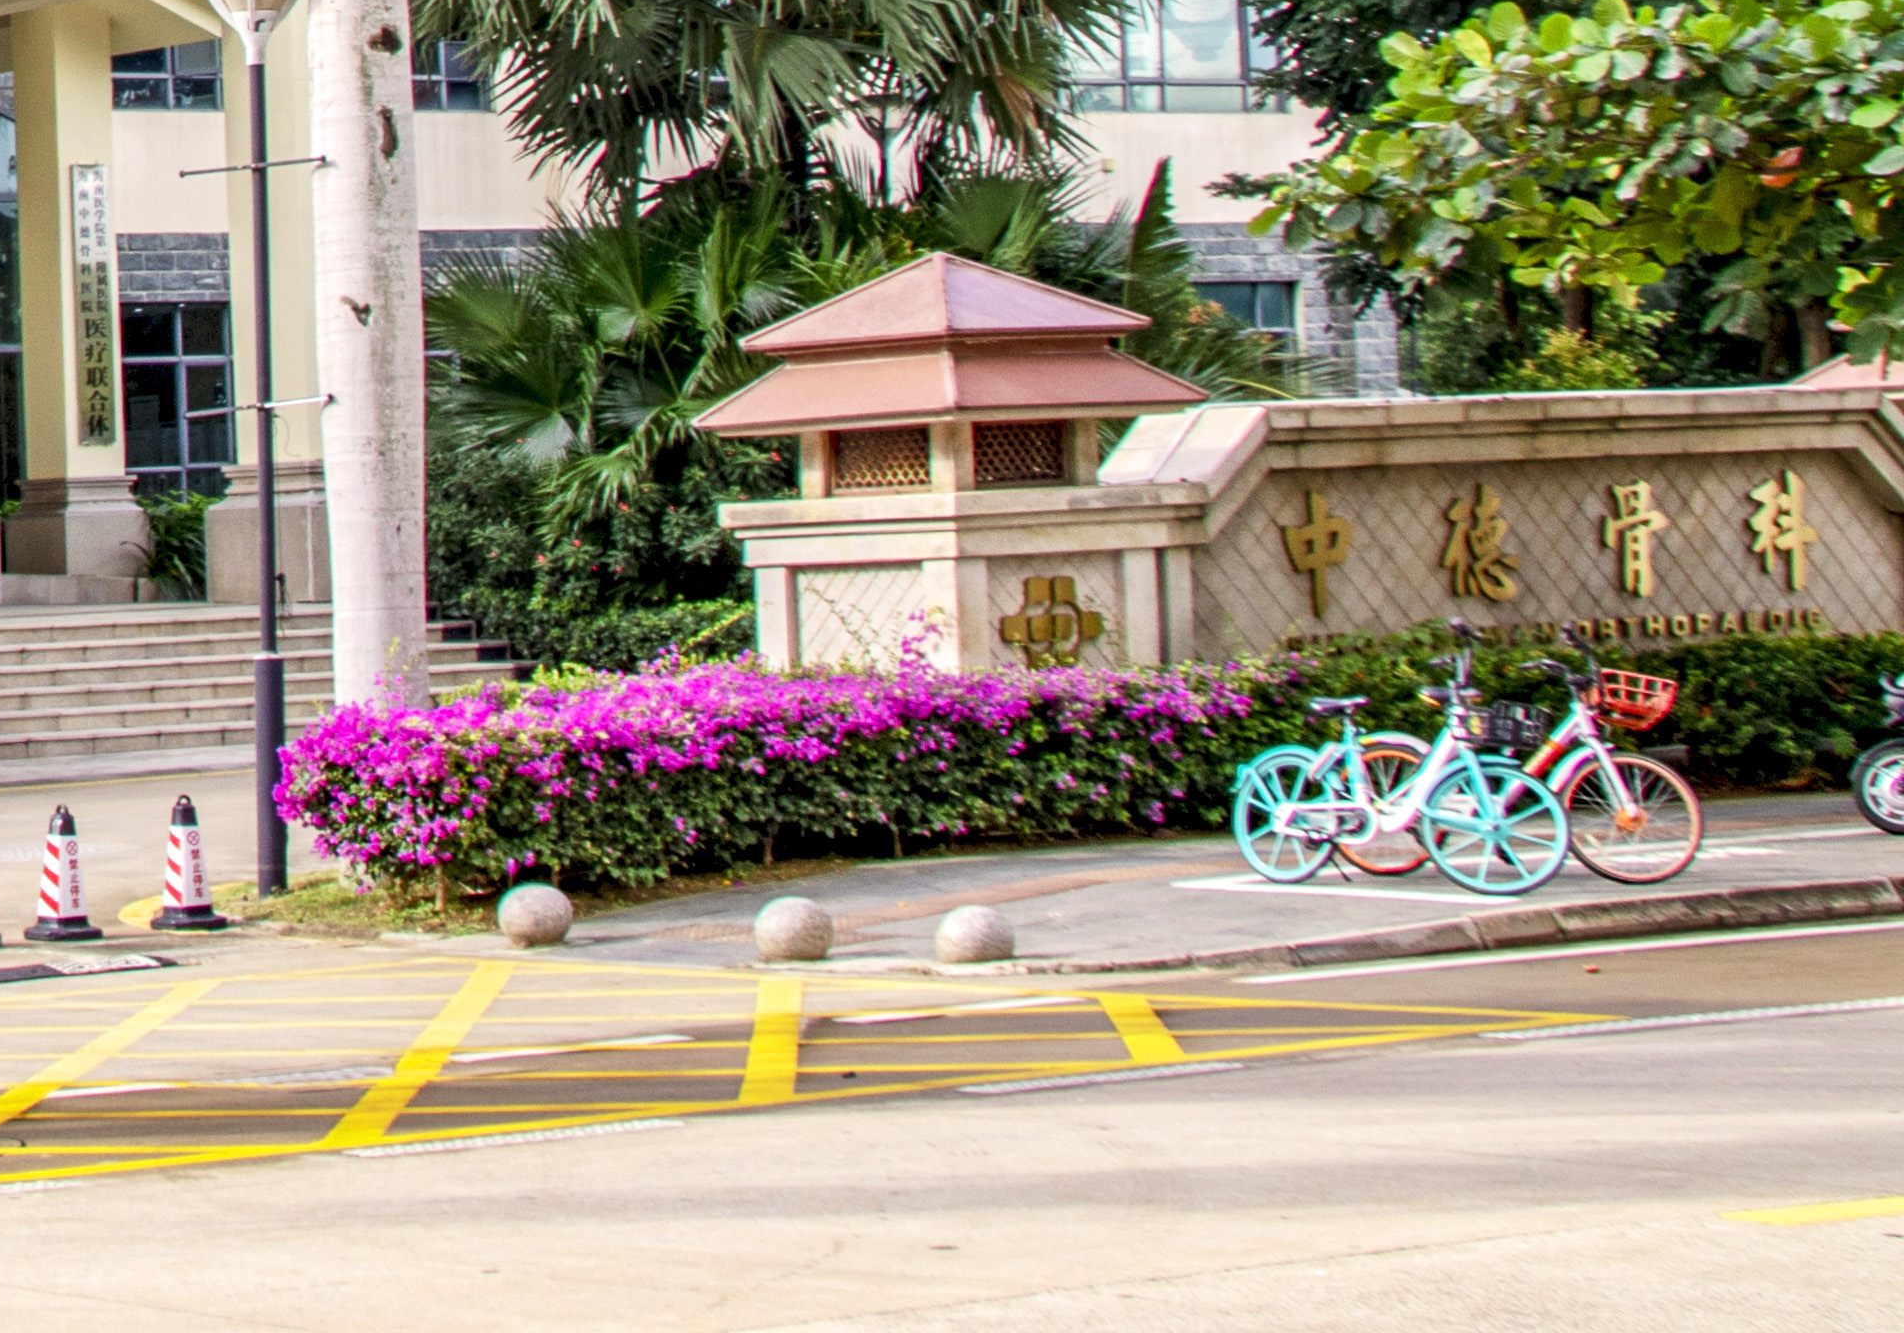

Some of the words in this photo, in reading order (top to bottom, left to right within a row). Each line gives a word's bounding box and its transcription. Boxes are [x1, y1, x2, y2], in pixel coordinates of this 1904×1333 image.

[85, 318, 109, 436] 医疗联合体
[1282, 469, 1818, 619] 中德骨科
